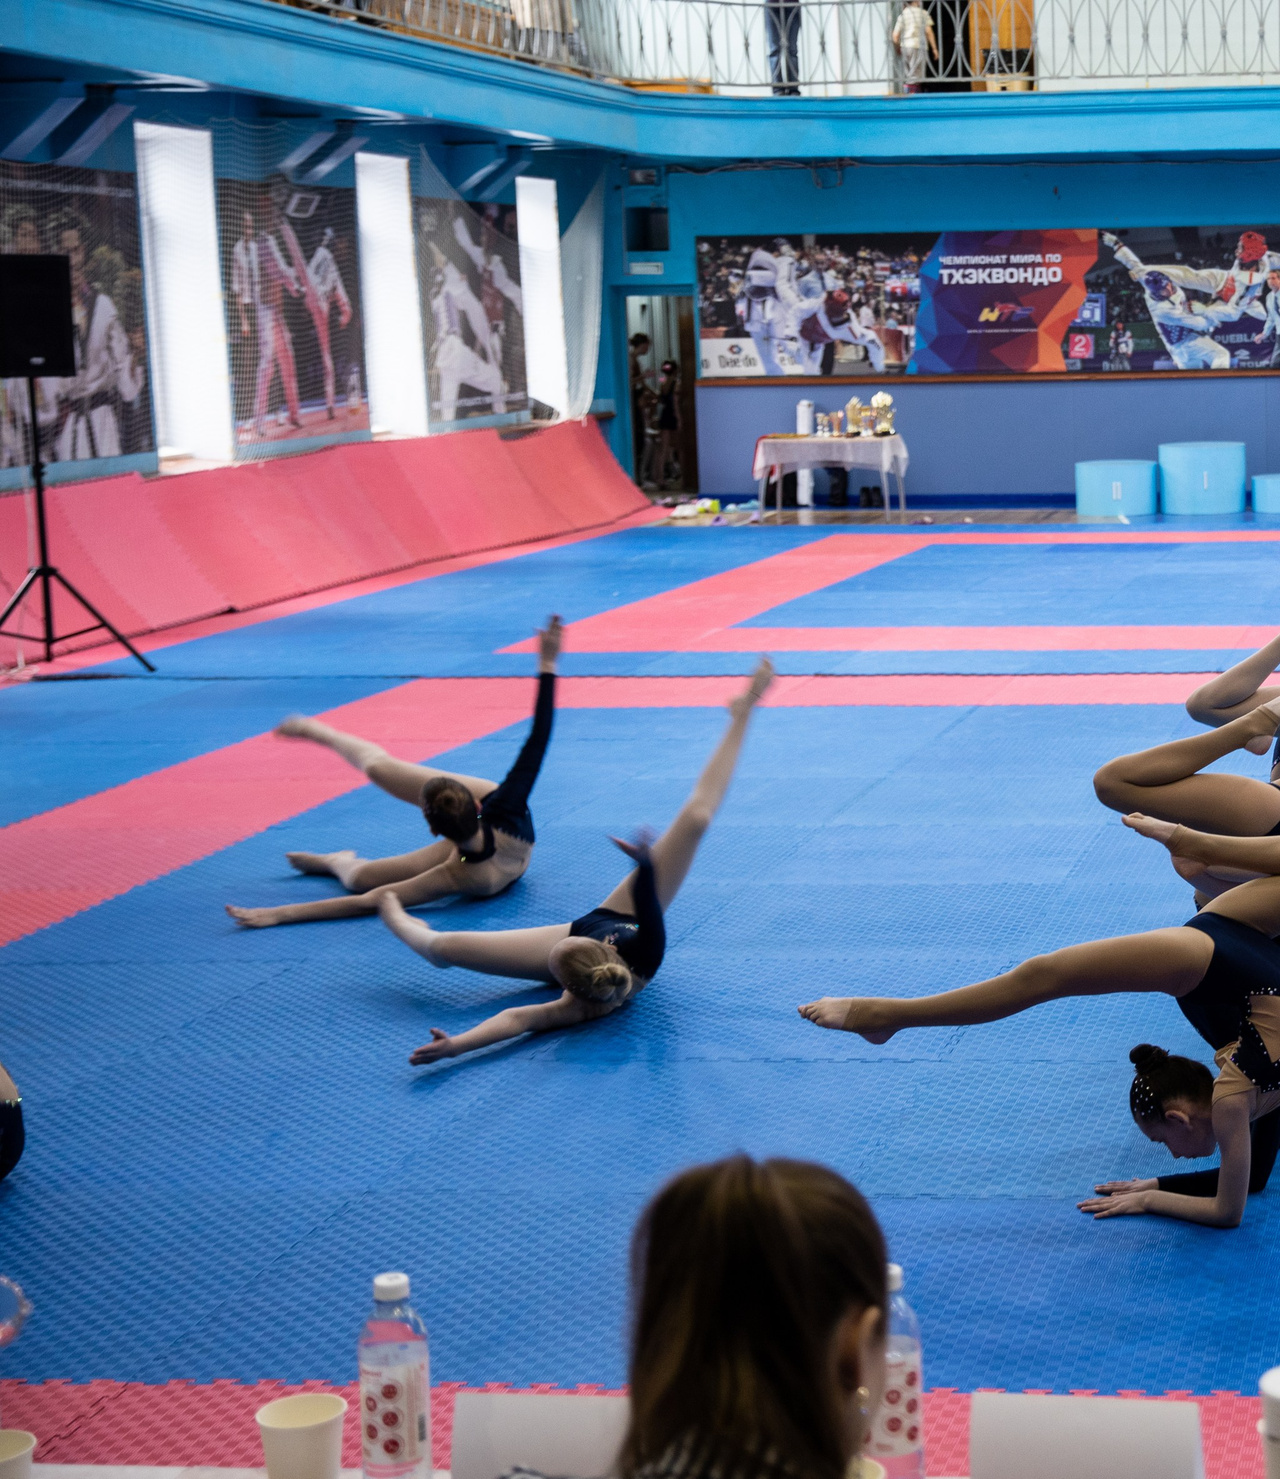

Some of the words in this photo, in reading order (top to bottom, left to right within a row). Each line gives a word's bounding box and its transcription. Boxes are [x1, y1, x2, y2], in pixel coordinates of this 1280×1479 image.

[939, 255, 1007, 265] ЧЕМПИОНАТ
[1010, 254, 1043, 264] МИРА
[1045, 253, 1062, 263] ПО
[939, 266, 1063, 286] ТХЭКВОНДО
[1074, 335, 1087, 352] 2
